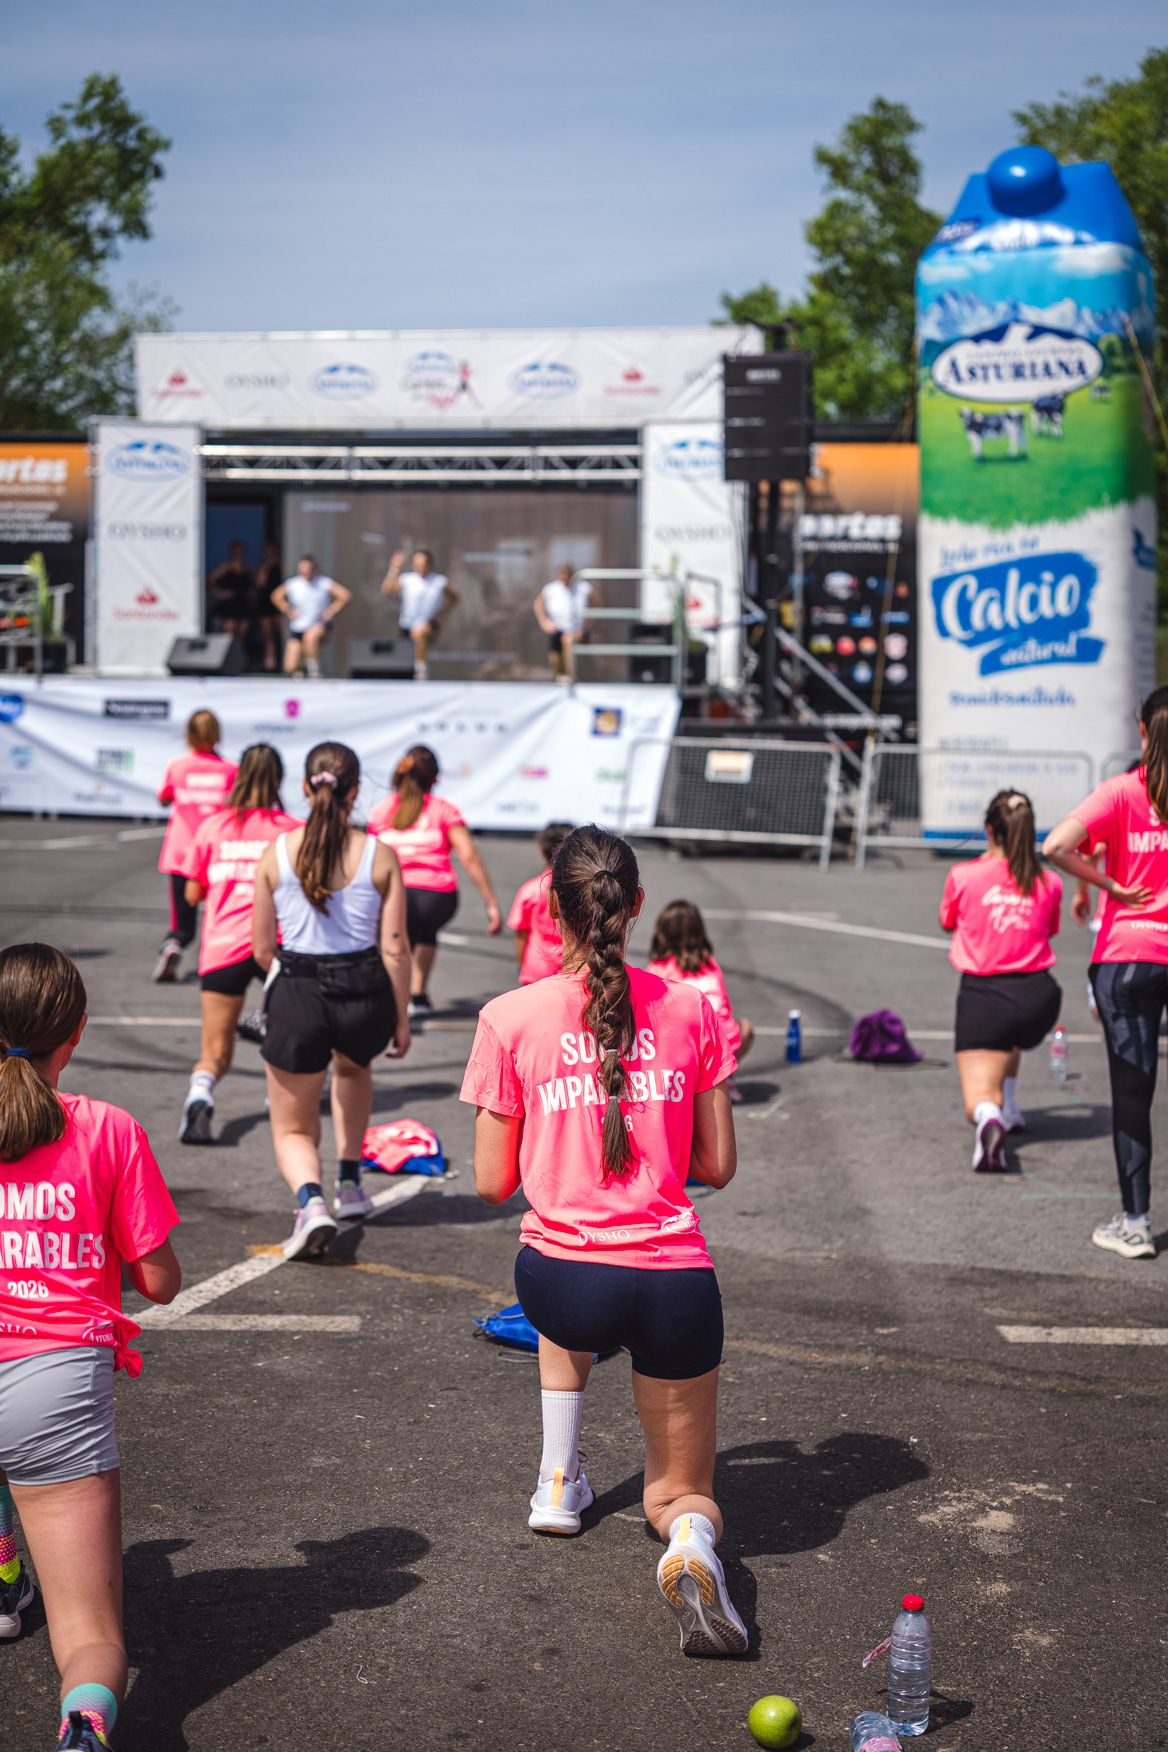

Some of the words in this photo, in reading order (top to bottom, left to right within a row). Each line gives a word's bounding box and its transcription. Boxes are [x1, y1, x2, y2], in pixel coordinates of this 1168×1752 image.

[945, 358, 1088, 385] ASTURIANA
[941, 567, 1081, 641] Calcio
[560, 1028, 656, 1065] SOOS
[578, 1229, 630, 1243] OYSHO
[7, 1279, 49, 1299] 2026
